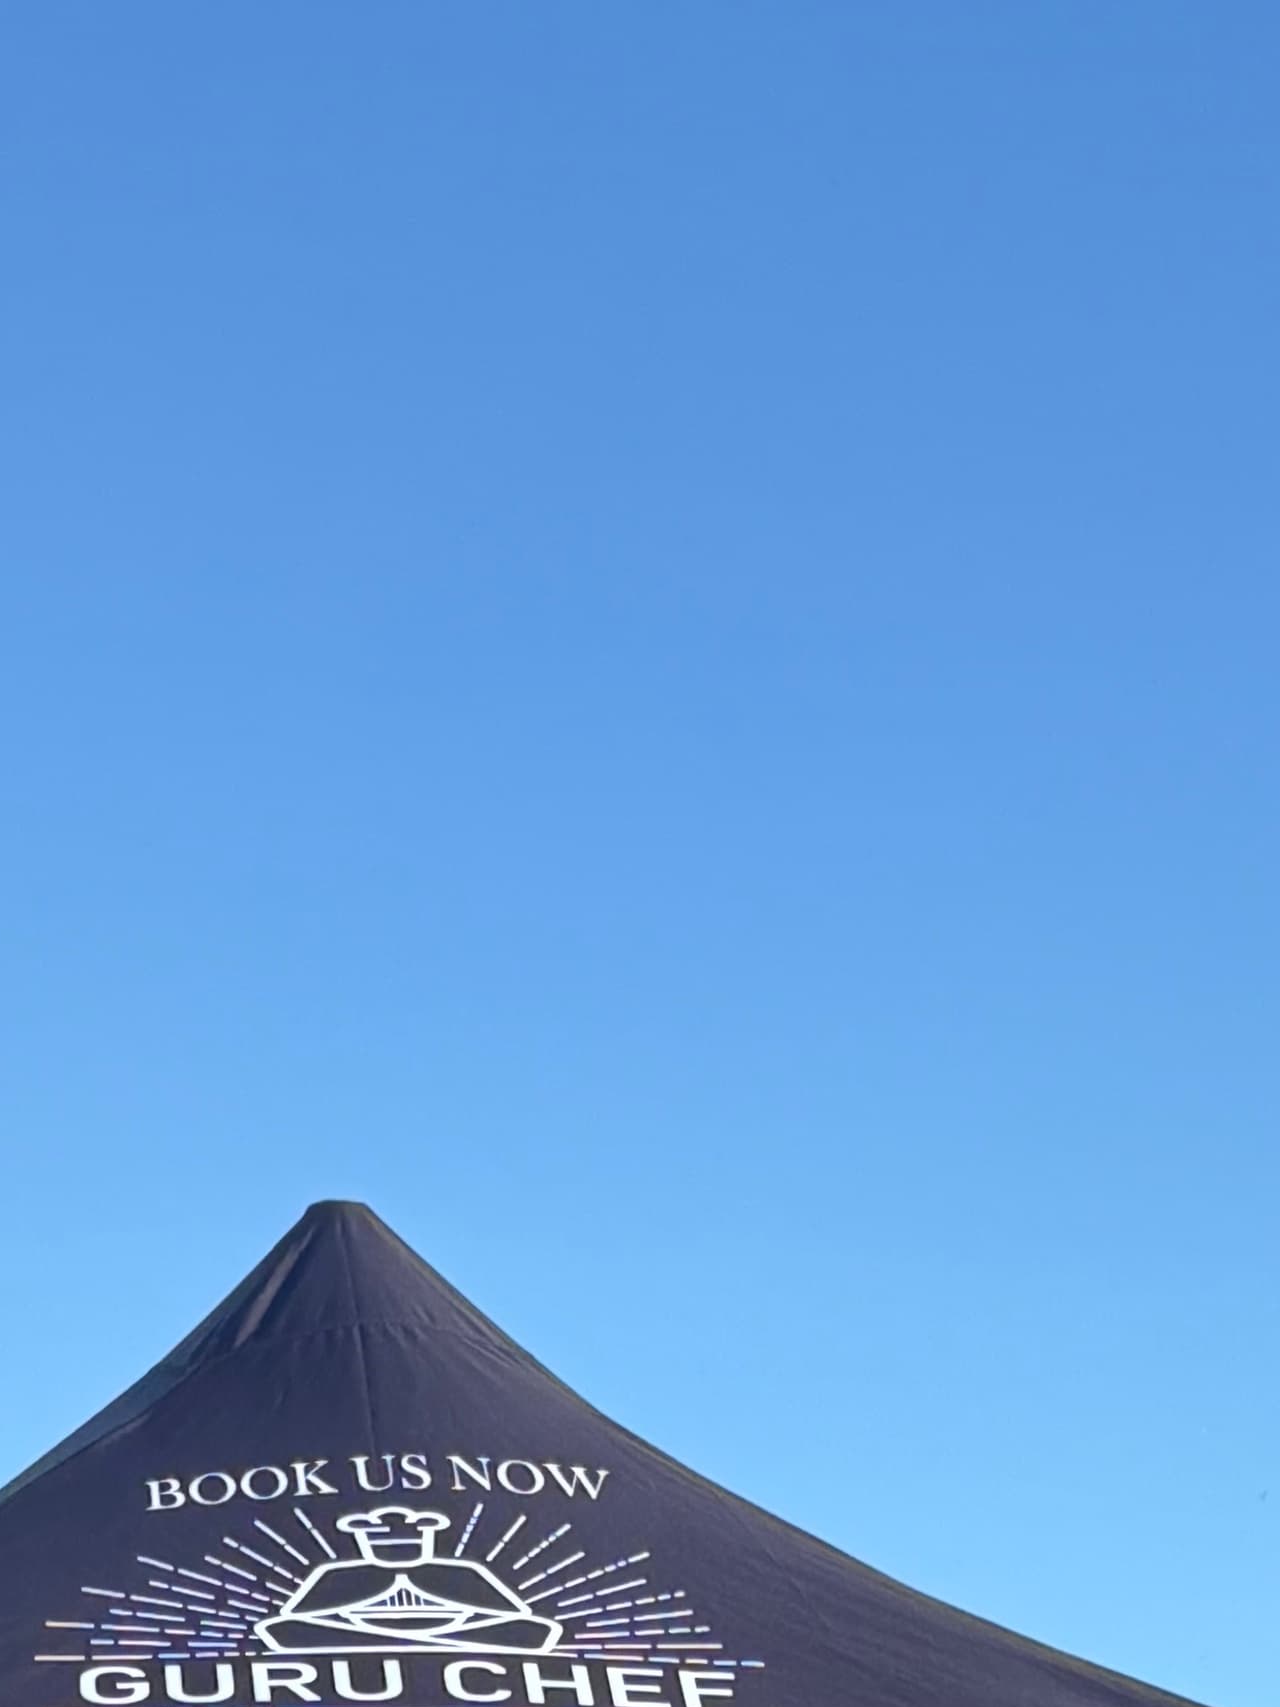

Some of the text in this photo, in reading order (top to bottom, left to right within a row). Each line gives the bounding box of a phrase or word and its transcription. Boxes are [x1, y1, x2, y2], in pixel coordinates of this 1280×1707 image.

[146, 1452, 611, 1512] BOOK US NOW
[79, 1660, 404, 1705] GURU
